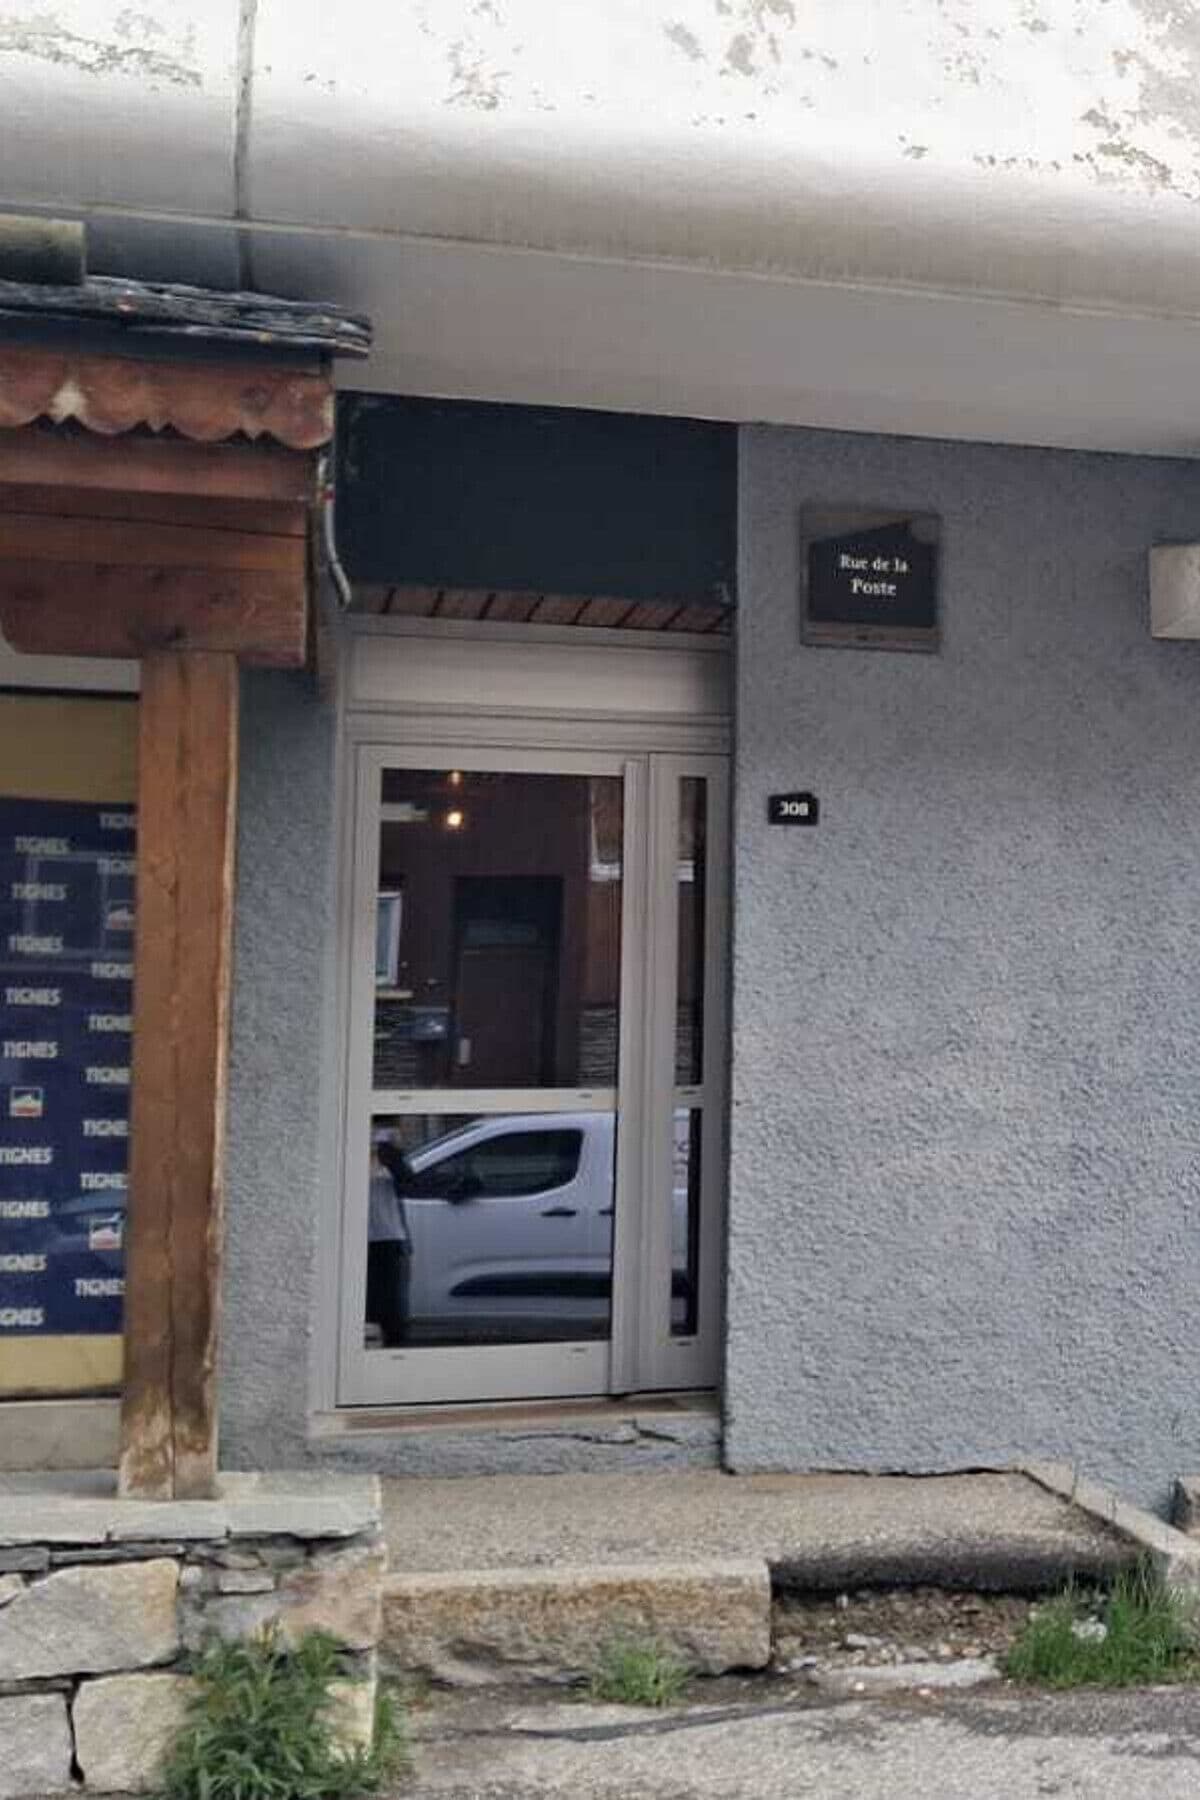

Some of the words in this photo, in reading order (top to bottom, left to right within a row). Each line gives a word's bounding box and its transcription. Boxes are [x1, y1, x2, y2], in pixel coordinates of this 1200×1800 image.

[840, 554, 868, 570] Rue
[872, 557, 889, 571] de
[895, 557, 908, 573] la
[851, 578, 896, 596] Poste
[3, 1041, 58, 1058] TIGNES
[86, 1067, 131, 1084] TIGNE
[82, 1120, 129, 1136] TIGNE
[80, 1173, 128, 1189] TIGNE
